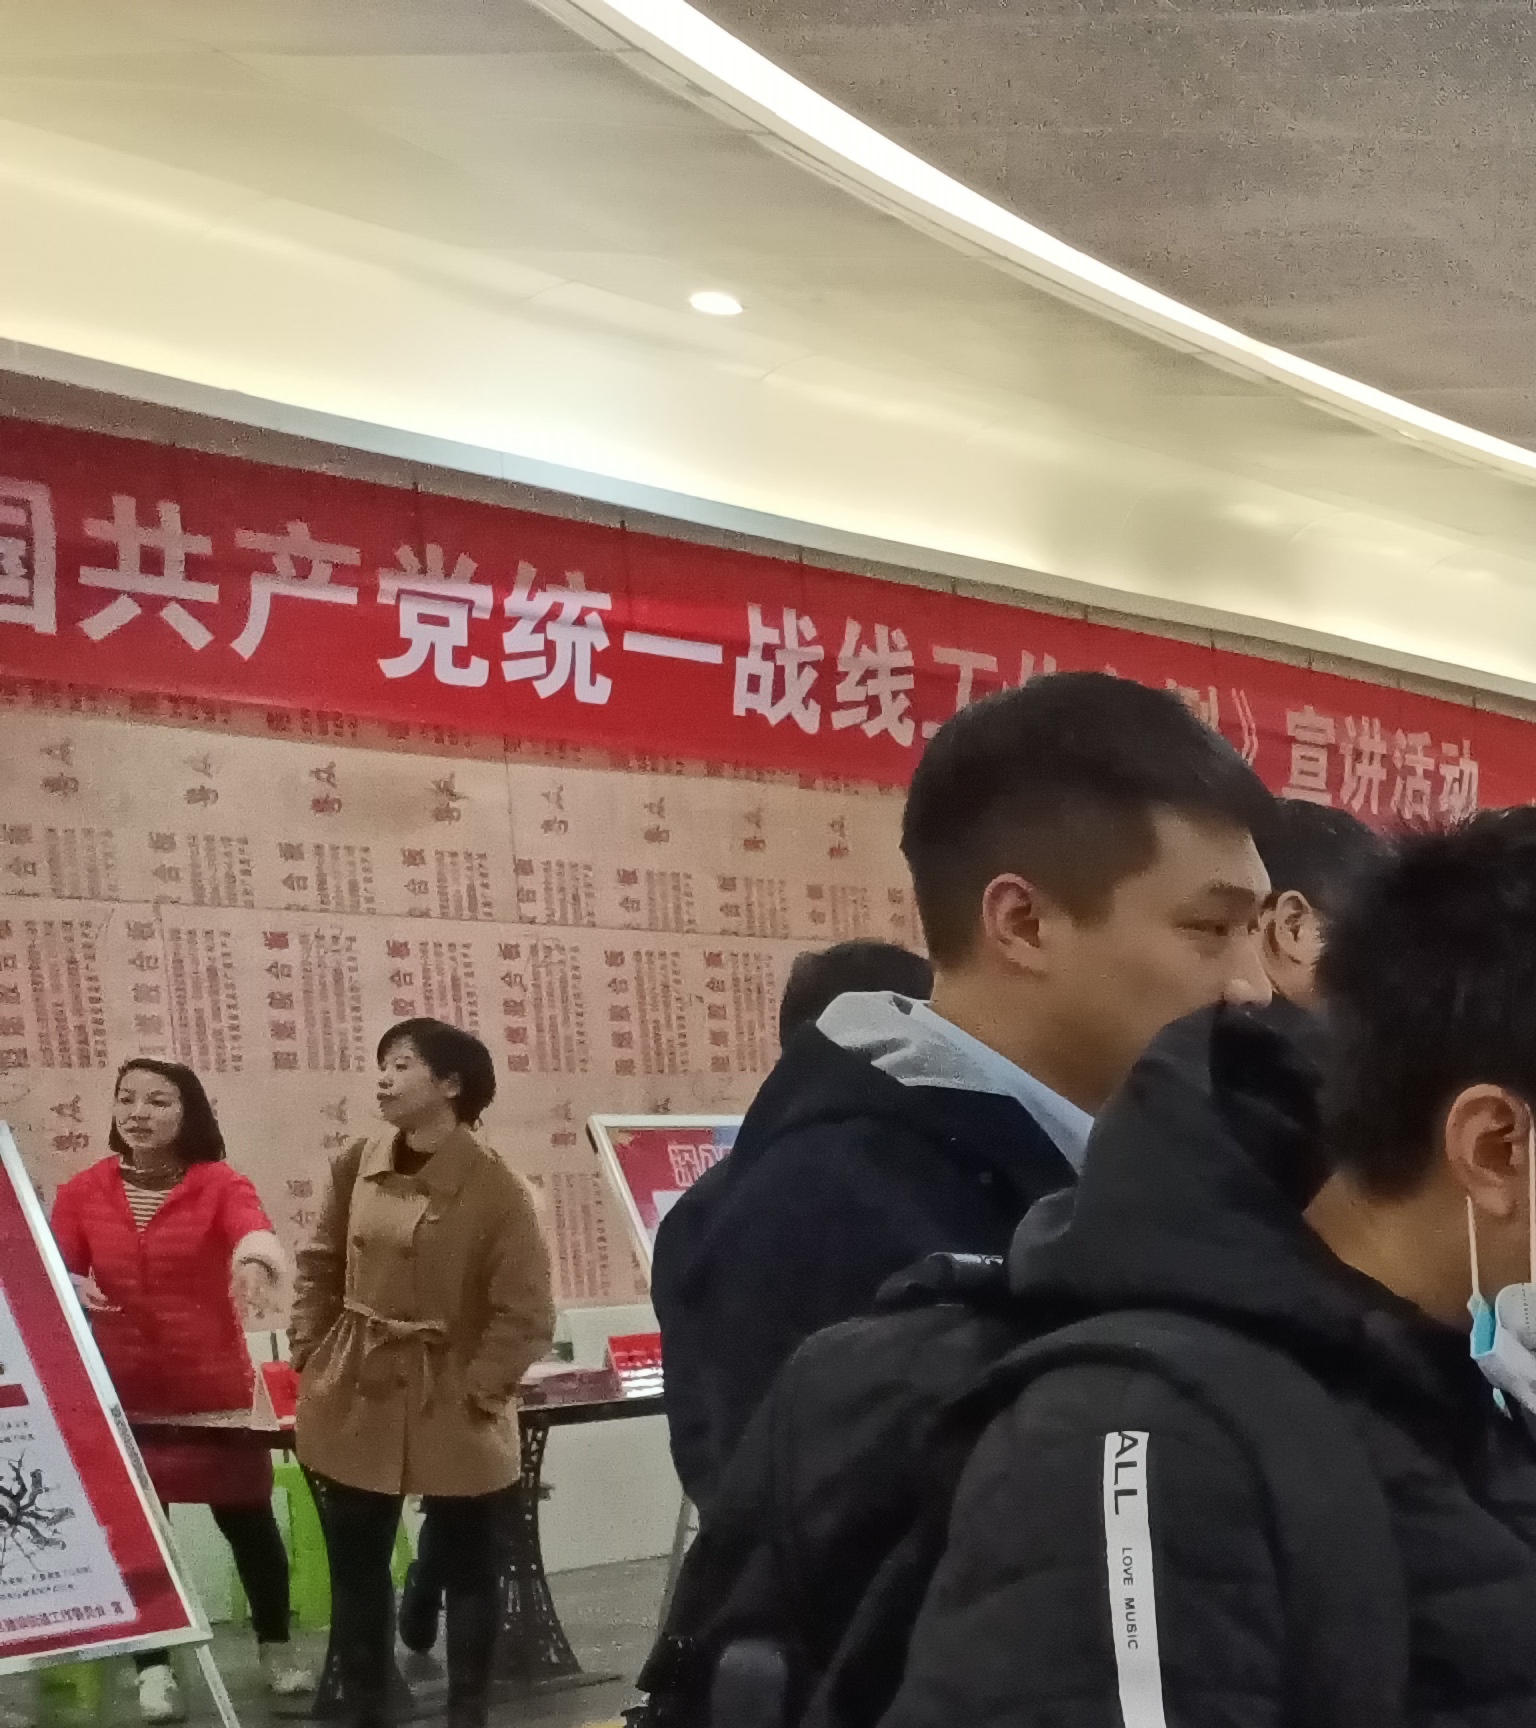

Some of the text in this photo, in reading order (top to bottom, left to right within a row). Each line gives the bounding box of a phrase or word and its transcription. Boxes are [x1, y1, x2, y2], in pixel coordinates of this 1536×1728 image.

[1114, 1431, 1138, 1515] ALL
[1122, 1547, 1138, 1650] LOVE MUSIC
